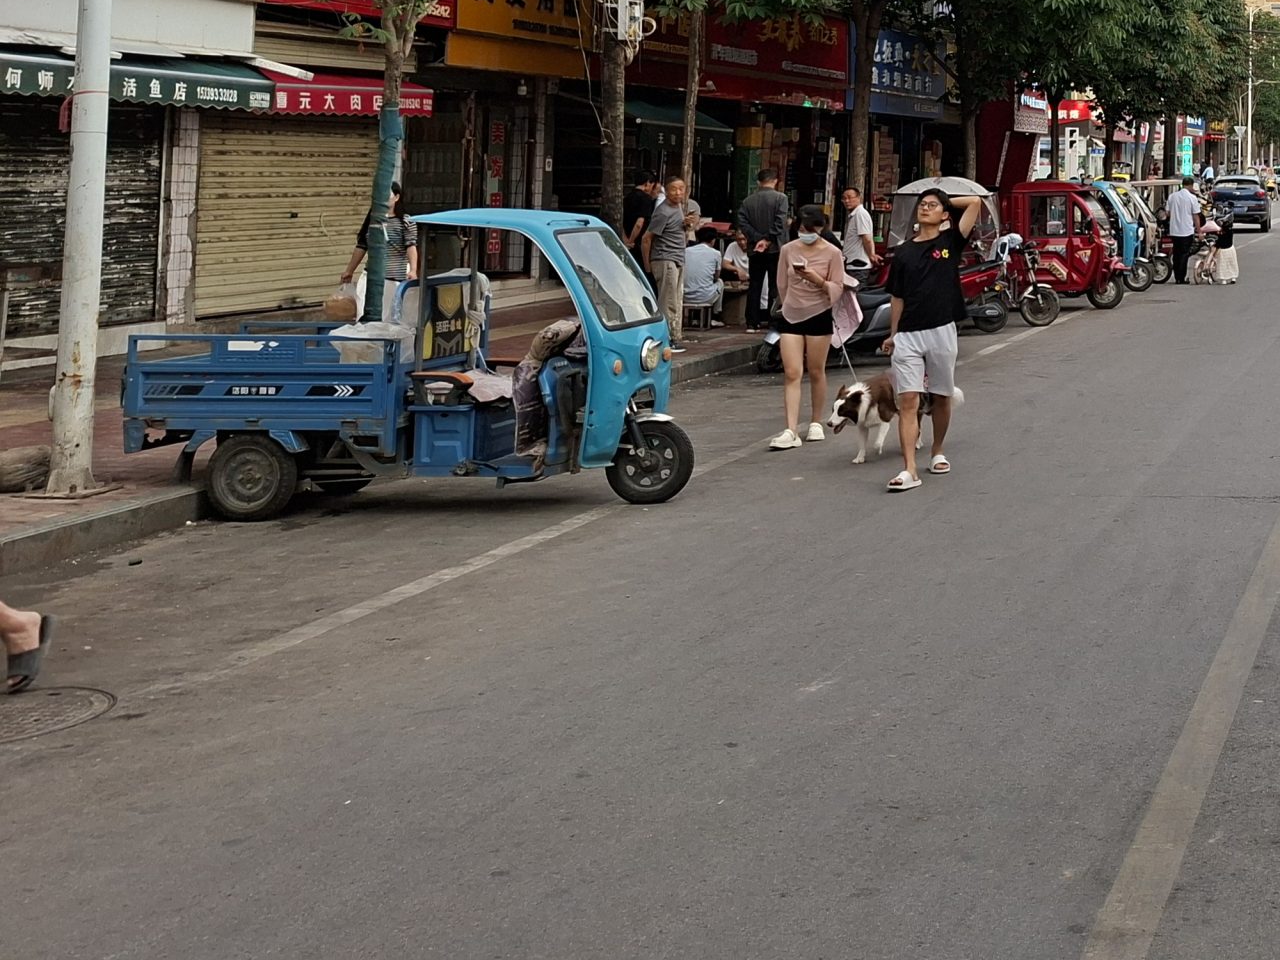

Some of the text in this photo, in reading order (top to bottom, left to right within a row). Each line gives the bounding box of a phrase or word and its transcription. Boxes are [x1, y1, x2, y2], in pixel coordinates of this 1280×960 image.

[5, 67, 187, 101] 何师活鱼店
